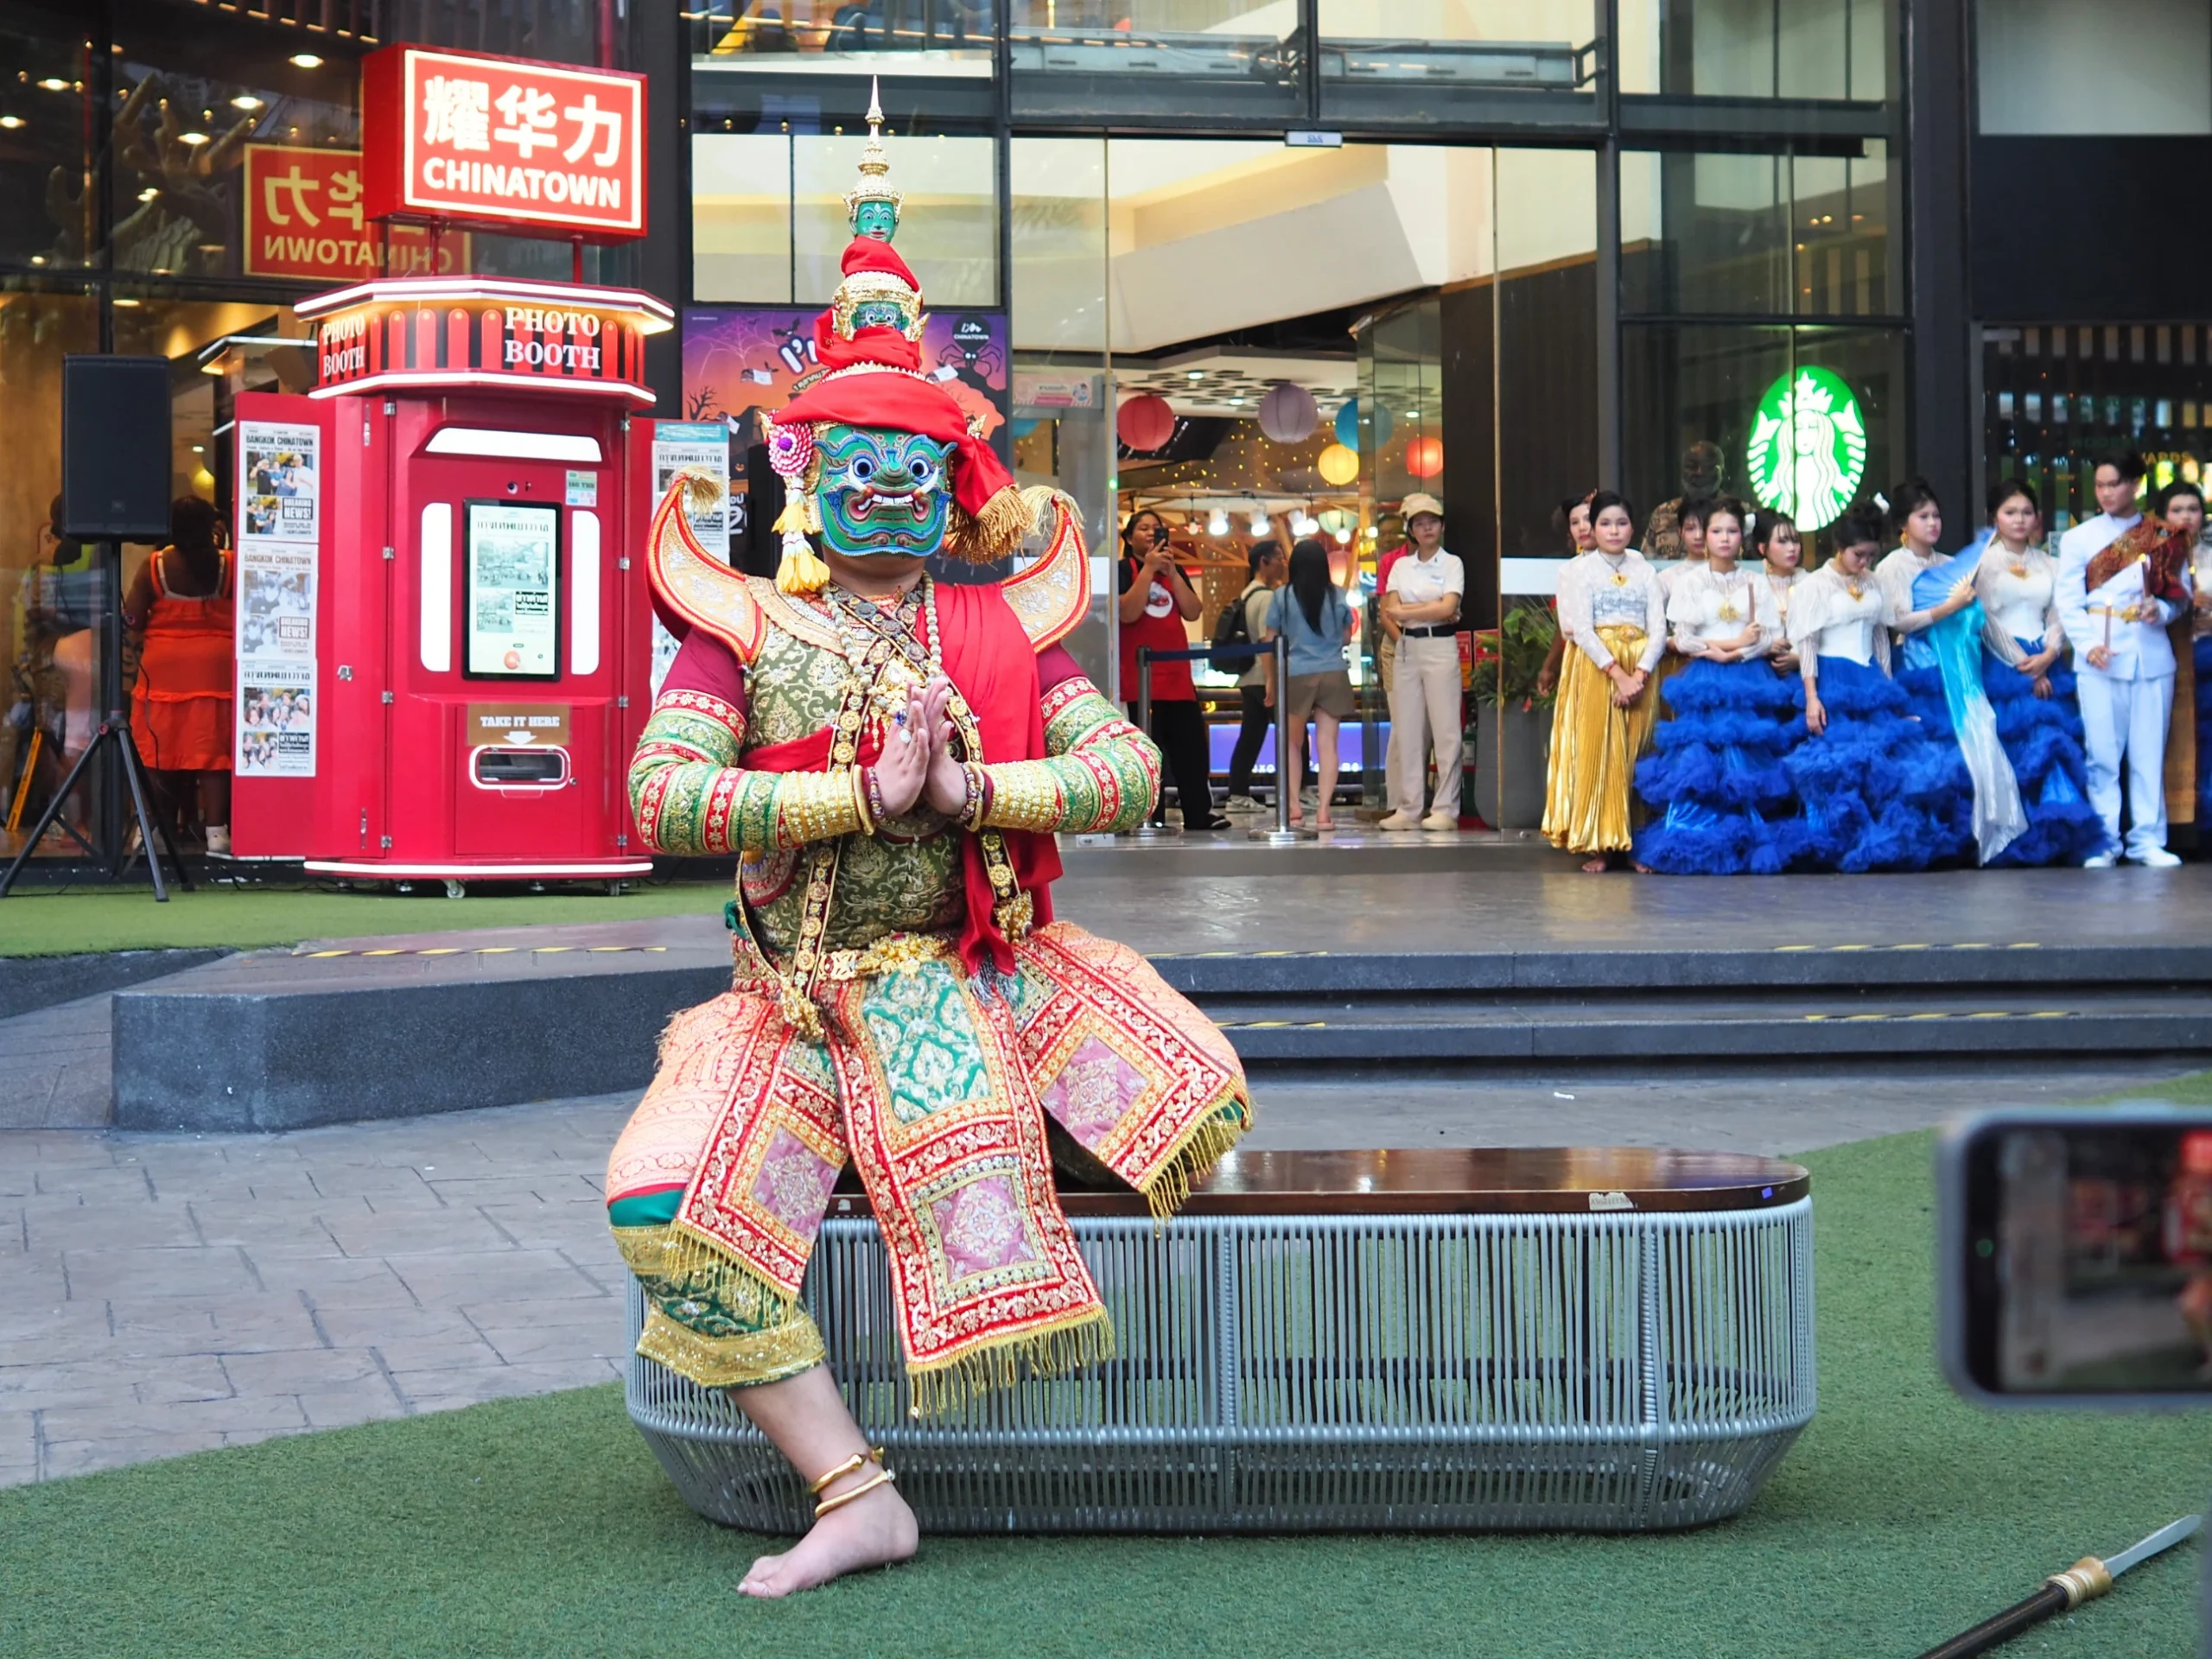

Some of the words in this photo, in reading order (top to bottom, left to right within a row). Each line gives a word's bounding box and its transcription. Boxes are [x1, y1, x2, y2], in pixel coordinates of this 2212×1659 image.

[423, 75, 622, 167] 耀华力
[423, 156, 620, 208] CHINATOWN
[322, 314, 365, 346] PHOTO
[505, 307, 600, 336] PHOTO
[323, 346, 365, 377] BOOTH
[505, 340, 601, 369] BOOTH
[246, 435, 275, 445] BANGKOK
[276, 436, 314, 447] CHINATOWN
[283, 507, 312, 518] NEWS!
[245, 554, 273, 563] BANGKOK
[275, 555, 312, 565] CHINATOWN
[480, 716, 512, 727] TAKE
[513, 716, 526, 727] IT
[528, 716, 560, 727] HERE
